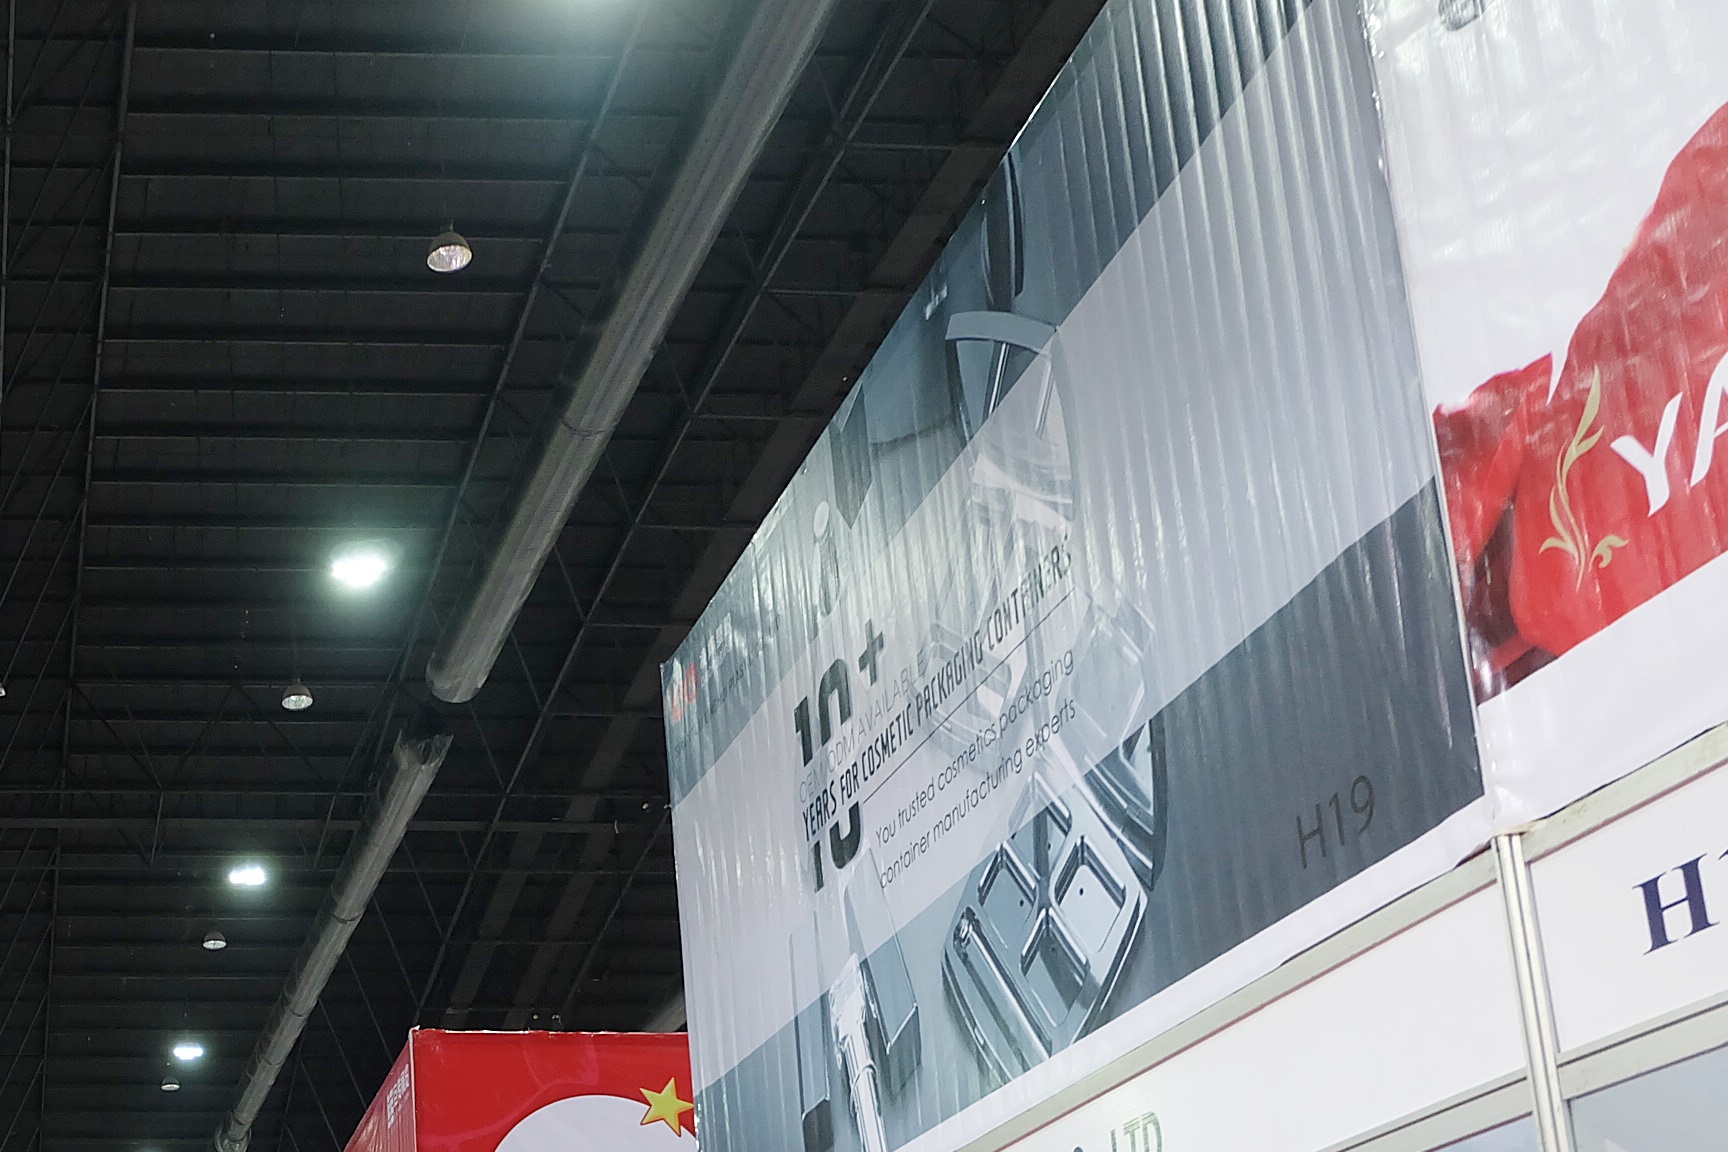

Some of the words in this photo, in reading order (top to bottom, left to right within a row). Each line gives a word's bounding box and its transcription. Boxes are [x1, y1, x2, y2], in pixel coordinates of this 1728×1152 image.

[801, 780, 838, 842] YEARS
[840, 763, 860, 807] FOR
[861, 700, 915, 784] COSMETIC
[915, 629, 984, 728] PACKAGING
[875, 818, 896, 849] You
[898, 777, 935, 829] trusted
[937, 728, 997, 791] cosmetics
[999, 650, 1074, 740] packaging
[880, 835, 932, 890] container
[932, 748, 1023, 840] manufacturing
[1025, 698, 1076, 758] experts
[1295, 774, 1376, 869] H19
[1630, 848, 1728, 957] H
